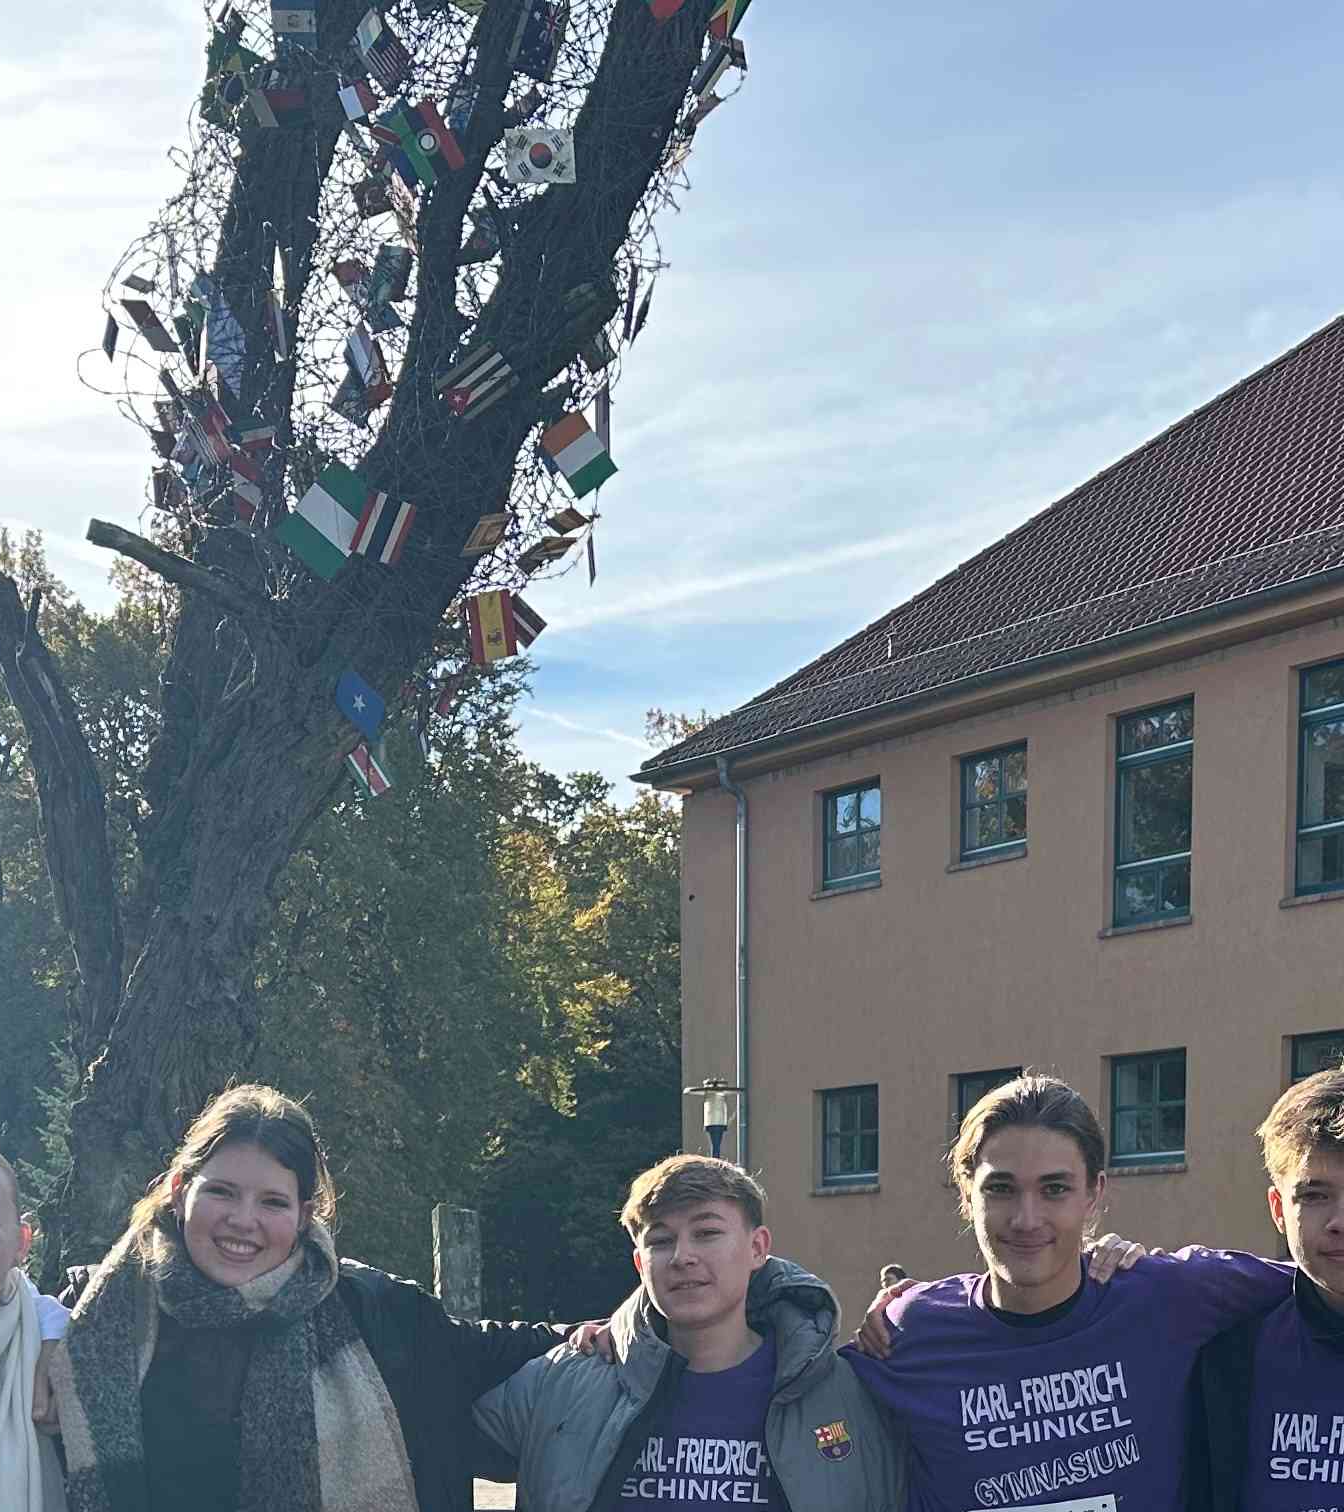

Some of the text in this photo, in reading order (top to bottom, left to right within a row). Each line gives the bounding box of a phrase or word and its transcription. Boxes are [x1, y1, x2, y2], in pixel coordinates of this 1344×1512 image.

[959, 1361, 1128, 1427] KARL-FRIEDRICH
[964, 1406, 1132, 1451] SCHINKEL
[633, 1436, 771, 1477] ARL-FRIEDRICH
[974, 1434, 1141, 1507] GYMNASIUM
[620, 1477, 769, 1504] SCHINKEL
